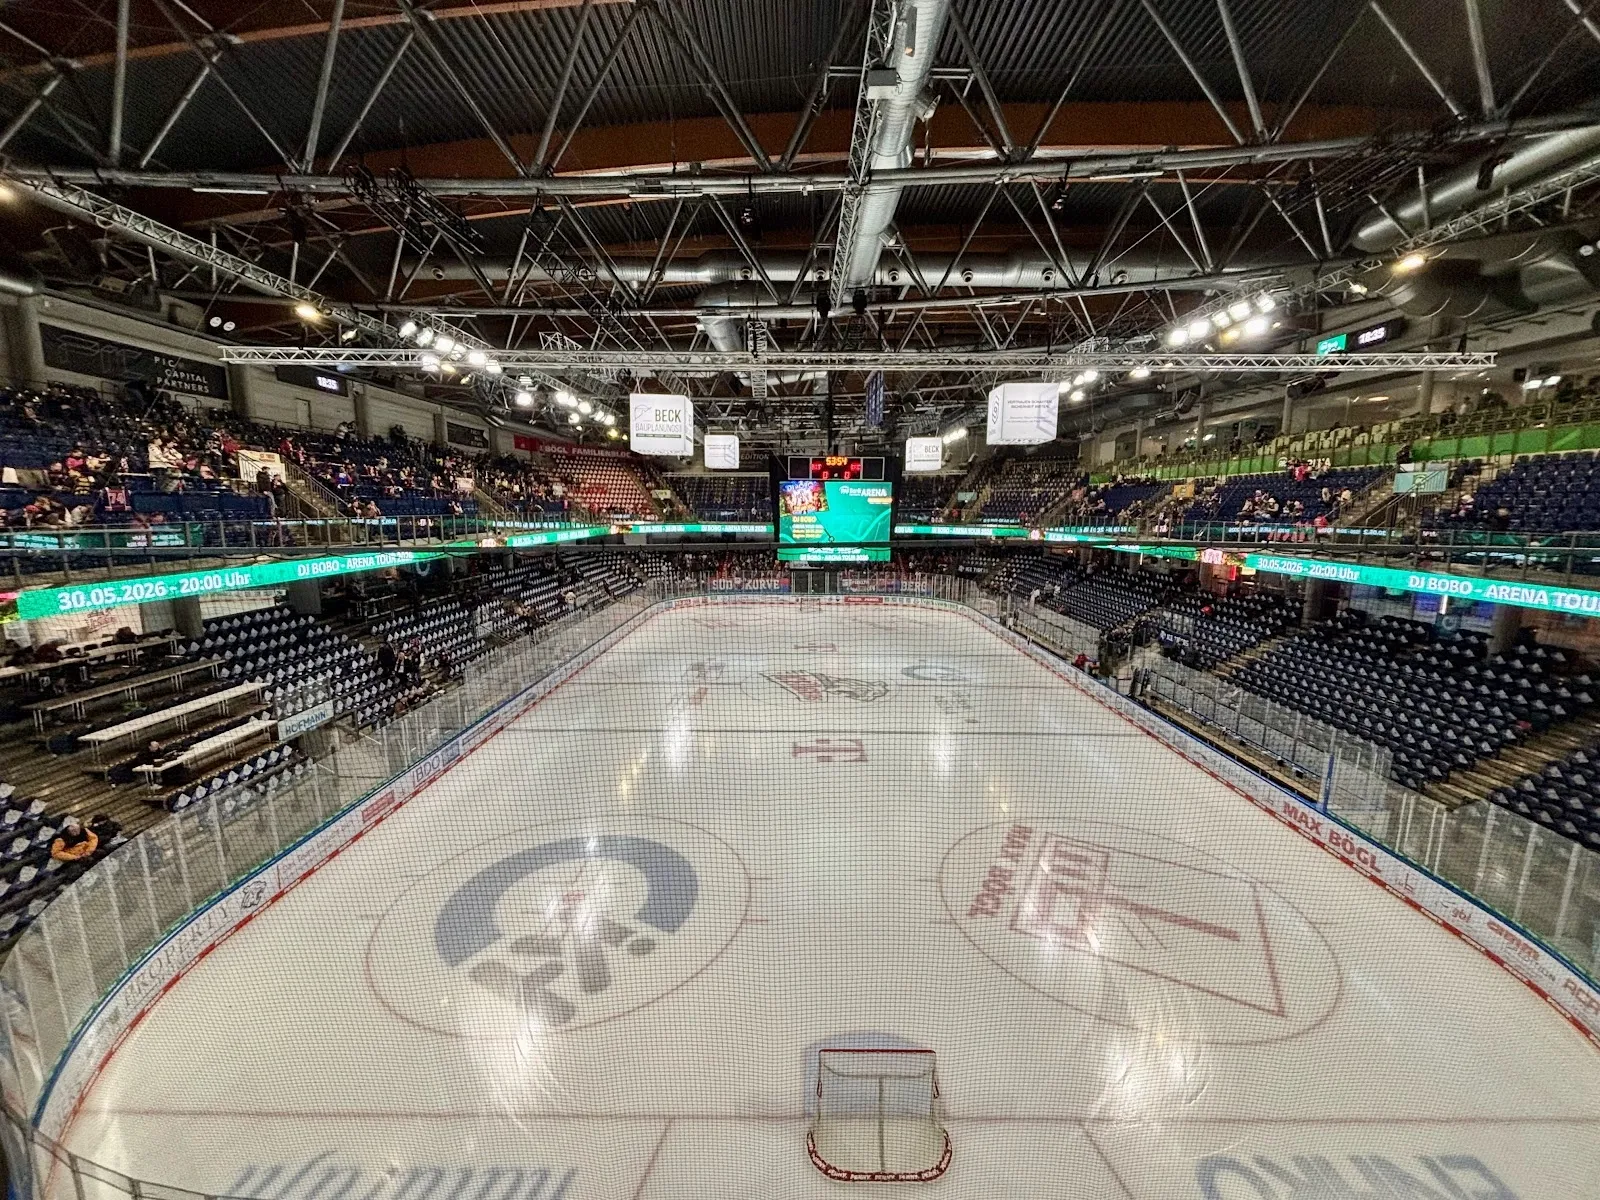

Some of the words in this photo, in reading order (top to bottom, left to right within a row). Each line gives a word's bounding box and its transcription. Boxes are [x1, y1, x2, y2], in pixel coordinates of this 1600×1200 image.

[154, 356, 176, 368] PIC
[157, 377, 210, 393] PARTNERS
[165, 369, 208, 384] CAPITAL
[655, 409, 681, 422] BECK
[861, 488, 888, 497] ARENA
[298, 565, 310, 576] DJ
[311, 560, 340, 575] BOBO
[346, 555, 375, 570] ARENA
[375, 552, 395, 566] TOUR
[1257, 558, 1303, 573] 30.05.2026
[1309, 564, 1337, 577] 20:00
[1338, 567, 1360, 580] Uhr
[58, 582, 166, 610] 30.05.2026
[179, 573, 222, 594] 20:00
[225, 571, 251, 587] Uhr
[745, 579, 780, 590] KURVE
[1408, 575, 1425, 590] DJ
[1427, 577, 1473, 595] BOBO
[1484, 584, 1549, 605] ARENA
[1550, 592, 1600, 611] TOU
[285, 711, 326, 735] HOFMANN
[416, 755, 441, 782] BDO
[1283, 802, 1324, 836] MAX
[1328, 828, 1382, 874] BÖGL
